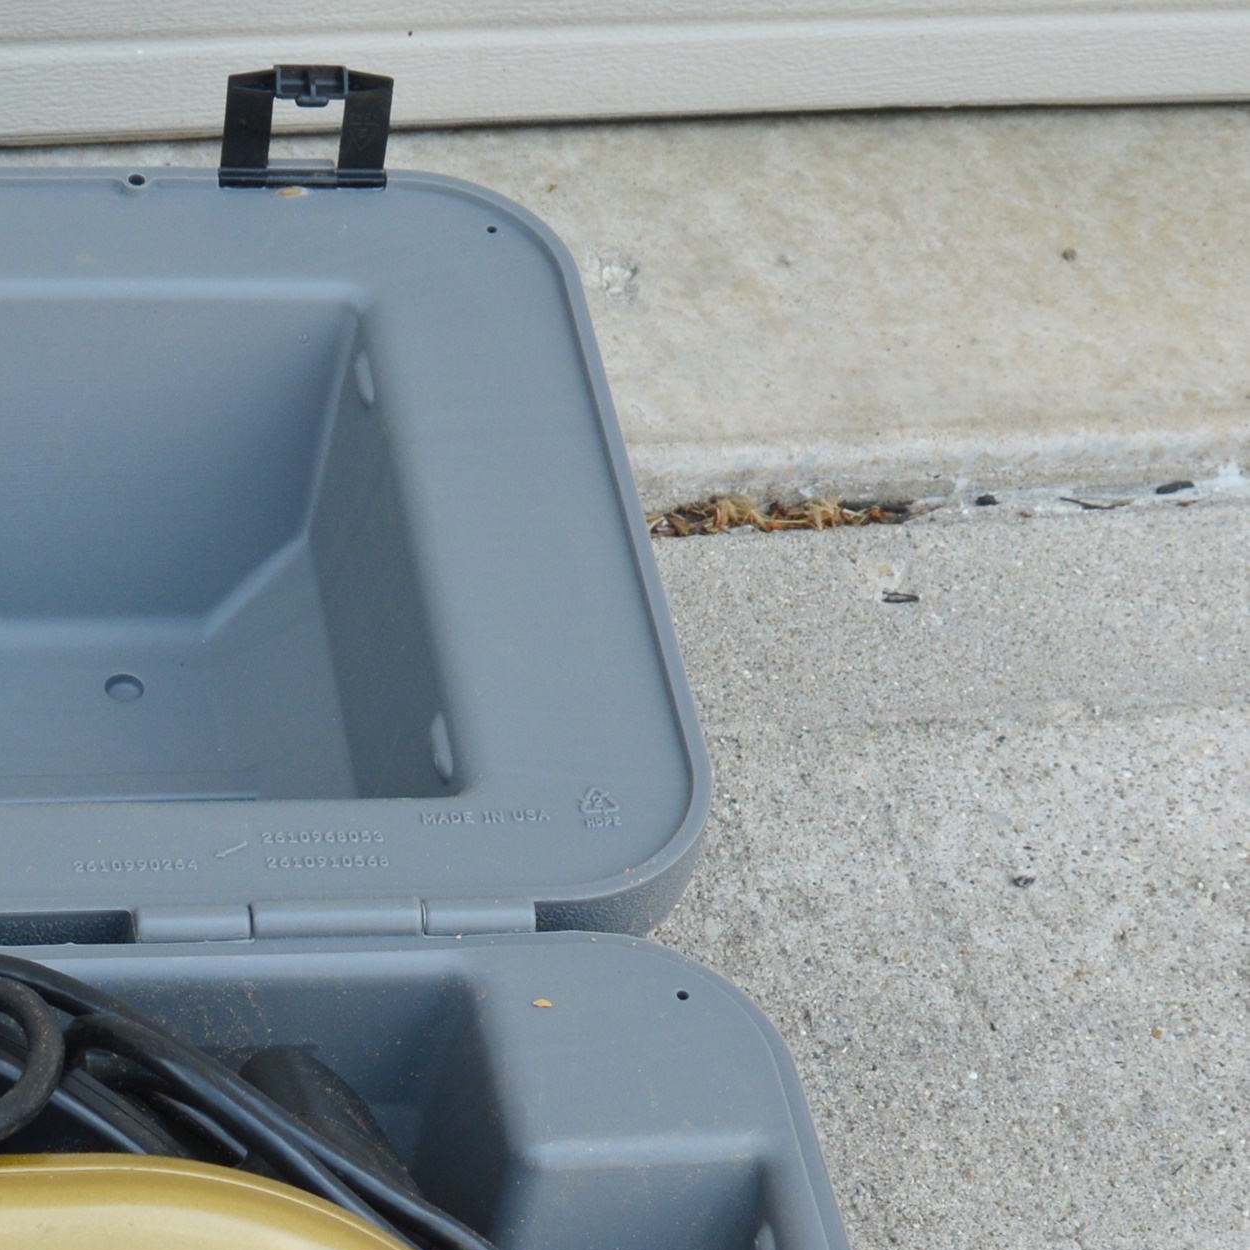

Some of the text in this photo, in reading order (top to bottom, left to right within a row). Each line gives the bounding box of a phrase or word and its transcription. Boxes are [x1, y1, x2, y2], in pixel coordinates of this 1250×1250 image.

[421, 808, 551, 825] MADE IN USA
[73, 859, 198, 873] 2610990264
